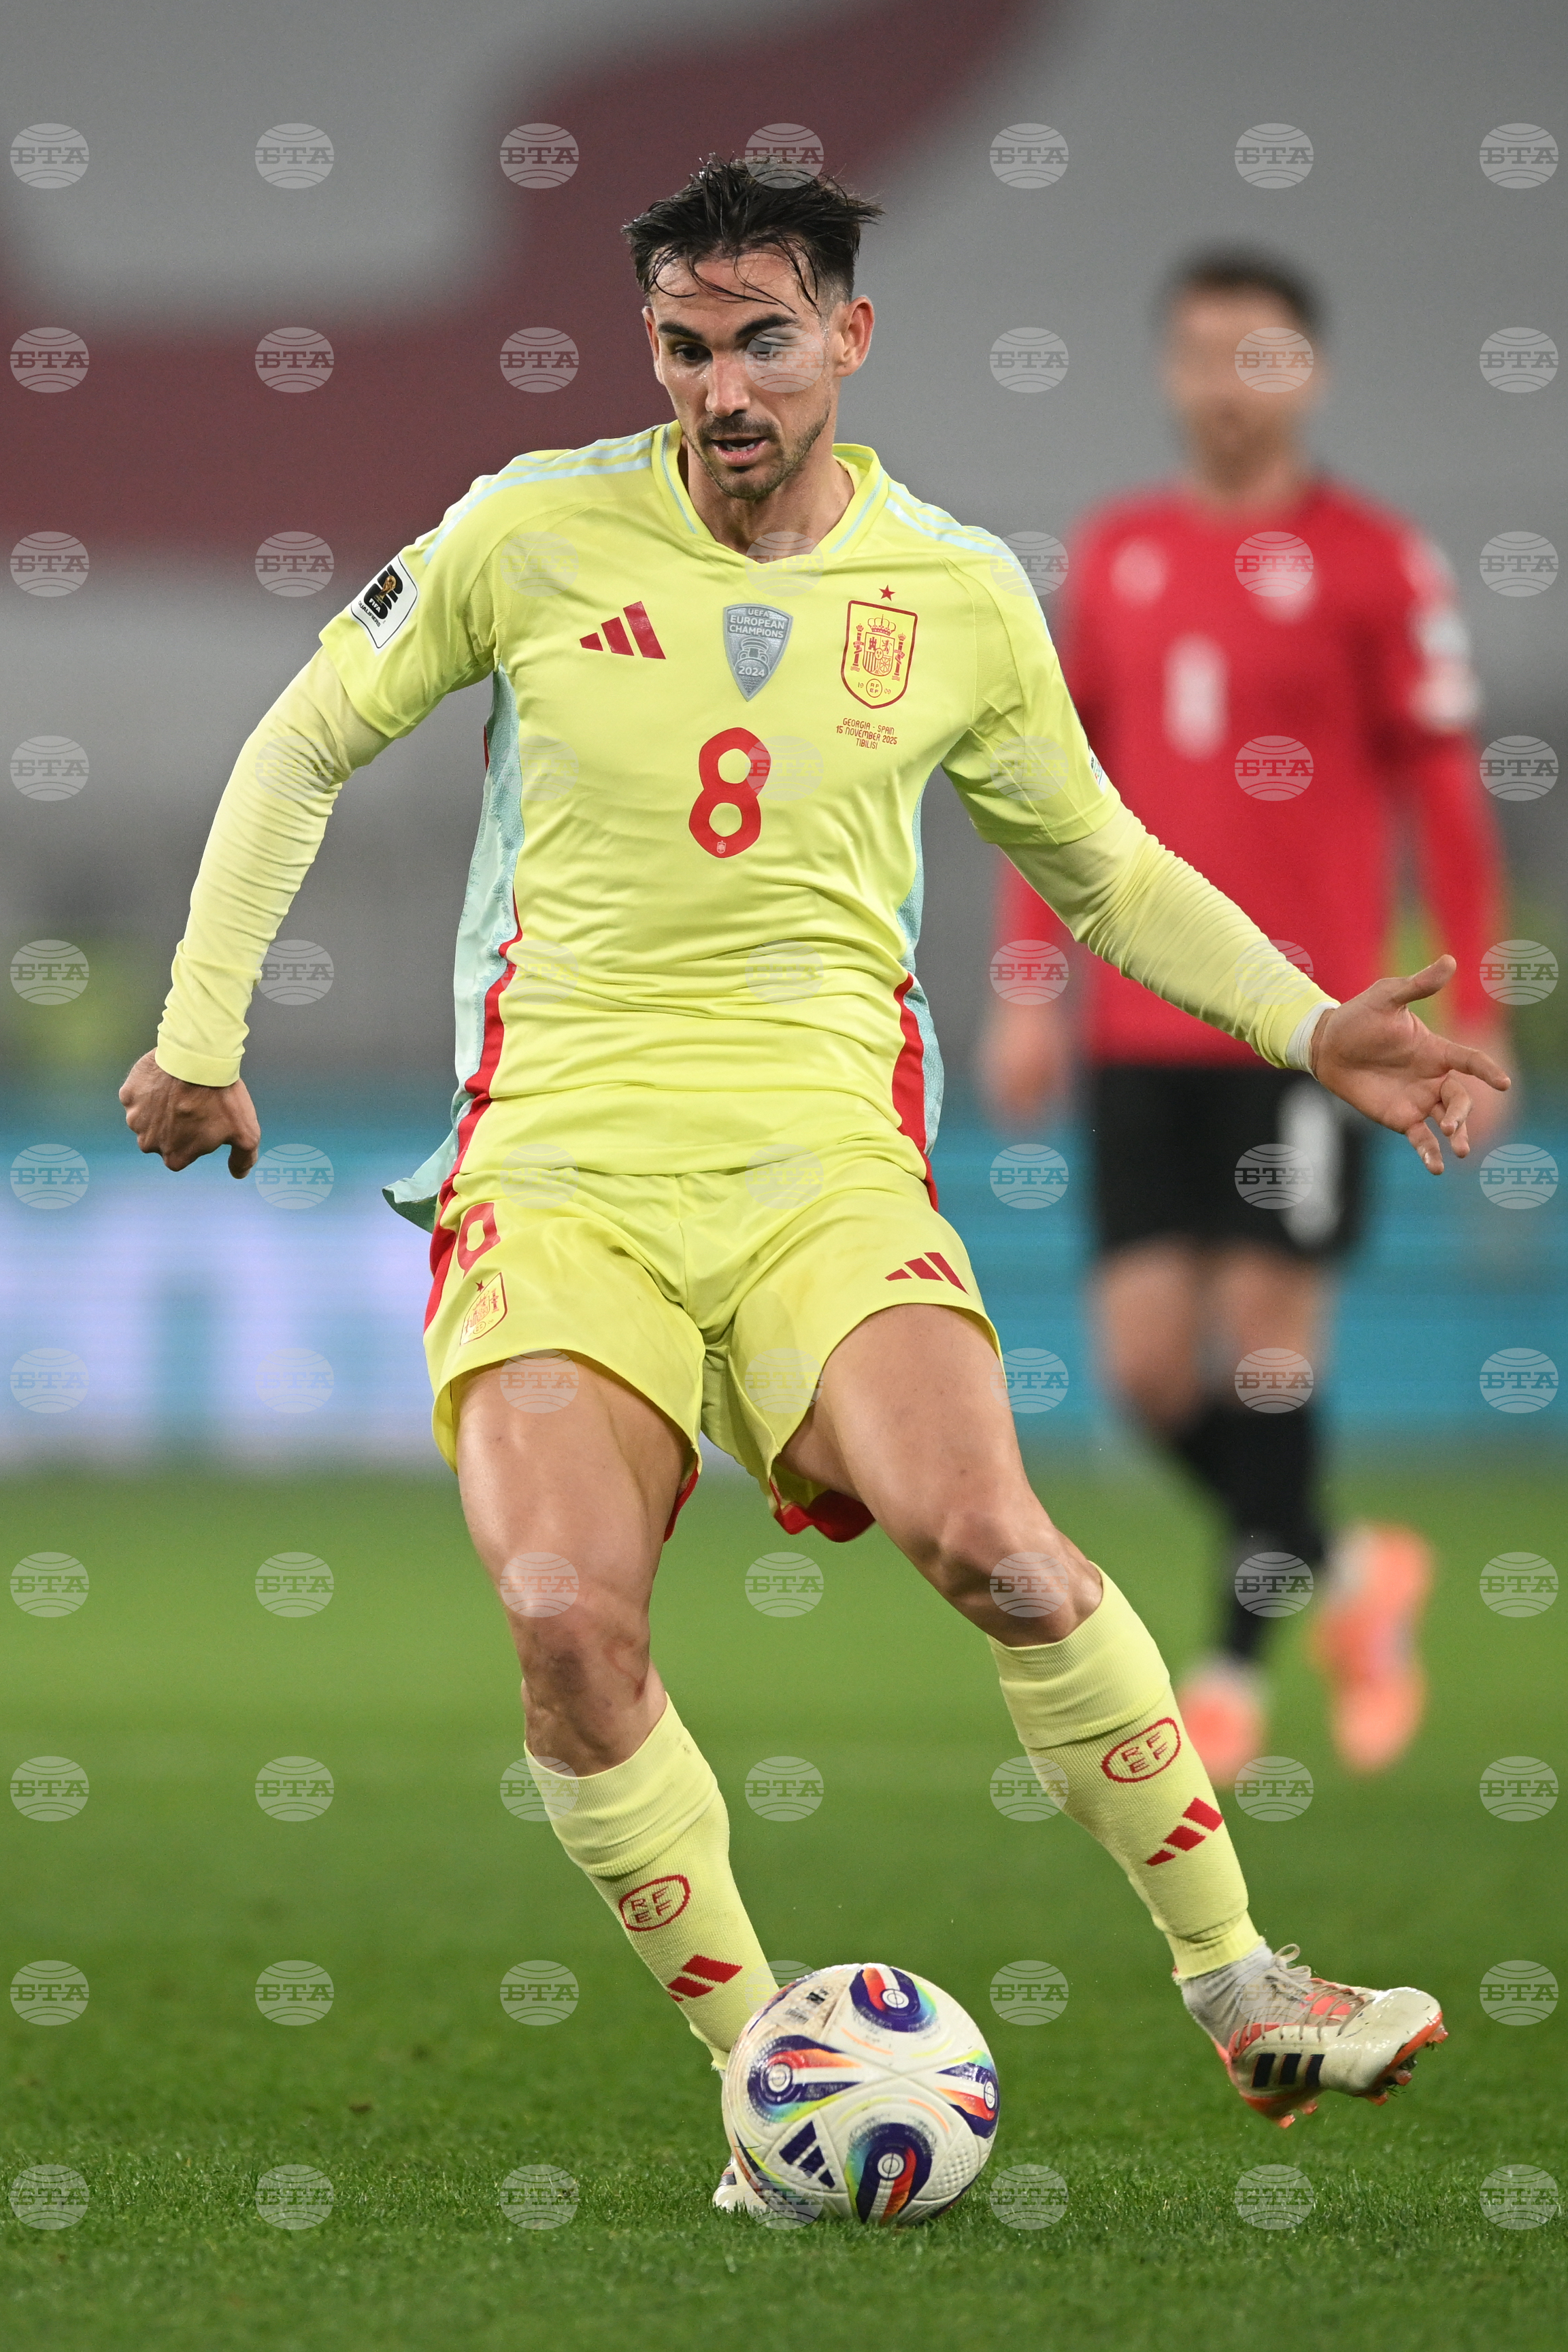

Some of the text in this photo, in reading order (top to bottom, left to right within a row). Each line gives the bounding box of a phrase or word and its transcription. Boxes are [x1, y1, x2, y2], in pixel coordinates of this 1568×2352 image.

[368, 598, 381, 613] FIFA
[358, 601, 381, 627] QUALIFIERS
[748, 609, 769, 618] UEFA
[730, 615, 784, 629] EUROPEAN
[729, 625, 784, 638] CHAMPIONS
[738, 665, 765, 677] 2024
[843, 718, 871, 730] GEORGIA
[878, 725, 895, 735] SPAIN
[836, 725, 898, 745] 15 NOVEMBER 2025
[688, 727, 771, 859] 8
